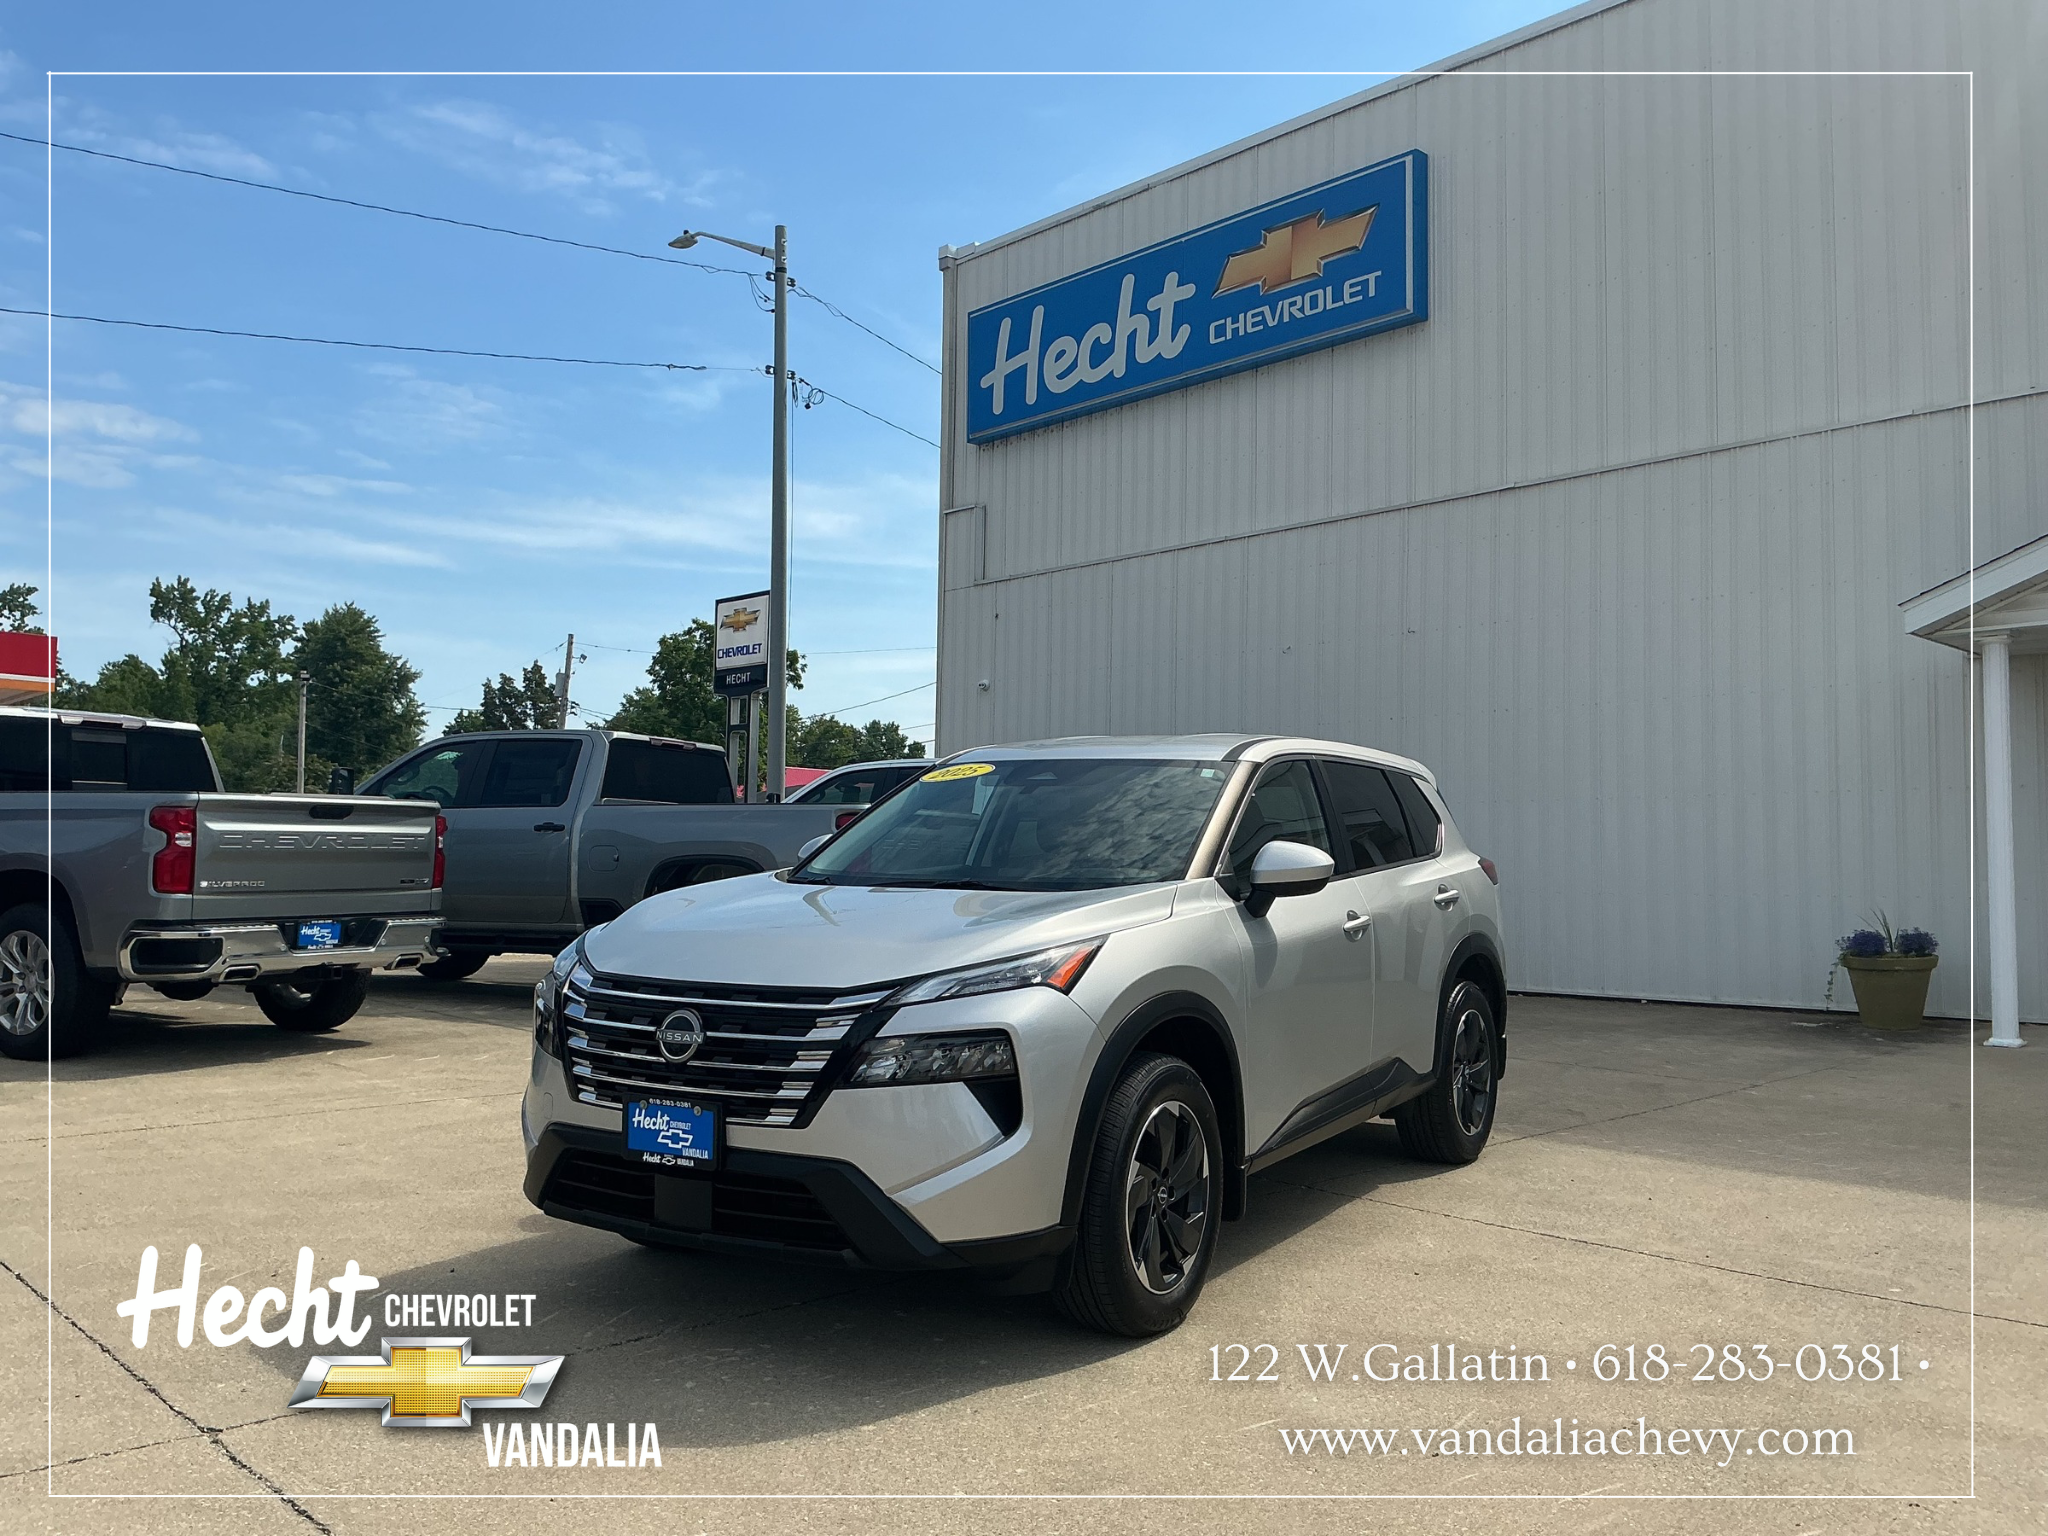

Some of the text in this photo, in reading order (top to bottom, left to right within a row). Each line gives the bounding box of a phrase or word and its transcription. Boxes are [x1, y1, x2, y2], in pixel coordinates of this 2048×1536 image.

[1209, 270, 1382, 345] CHEVROLET
[980, 271, 1197, 415] Hecht
[717, 643, 762, 659] CHEVROLET
[726, 672, 751, 685] HECHT
[927, 766, 987, 780] 2025
[219, 833, 426, 849] CHEVROLET
[656, 1030, 702, 1042] NISSAN
[649, 1098, 692, 1108] 618-283-0381
[632, 1107, 692, 1131] Hecht CHEVROLET
[682, 1147, 709, 1160] VANDALIA
